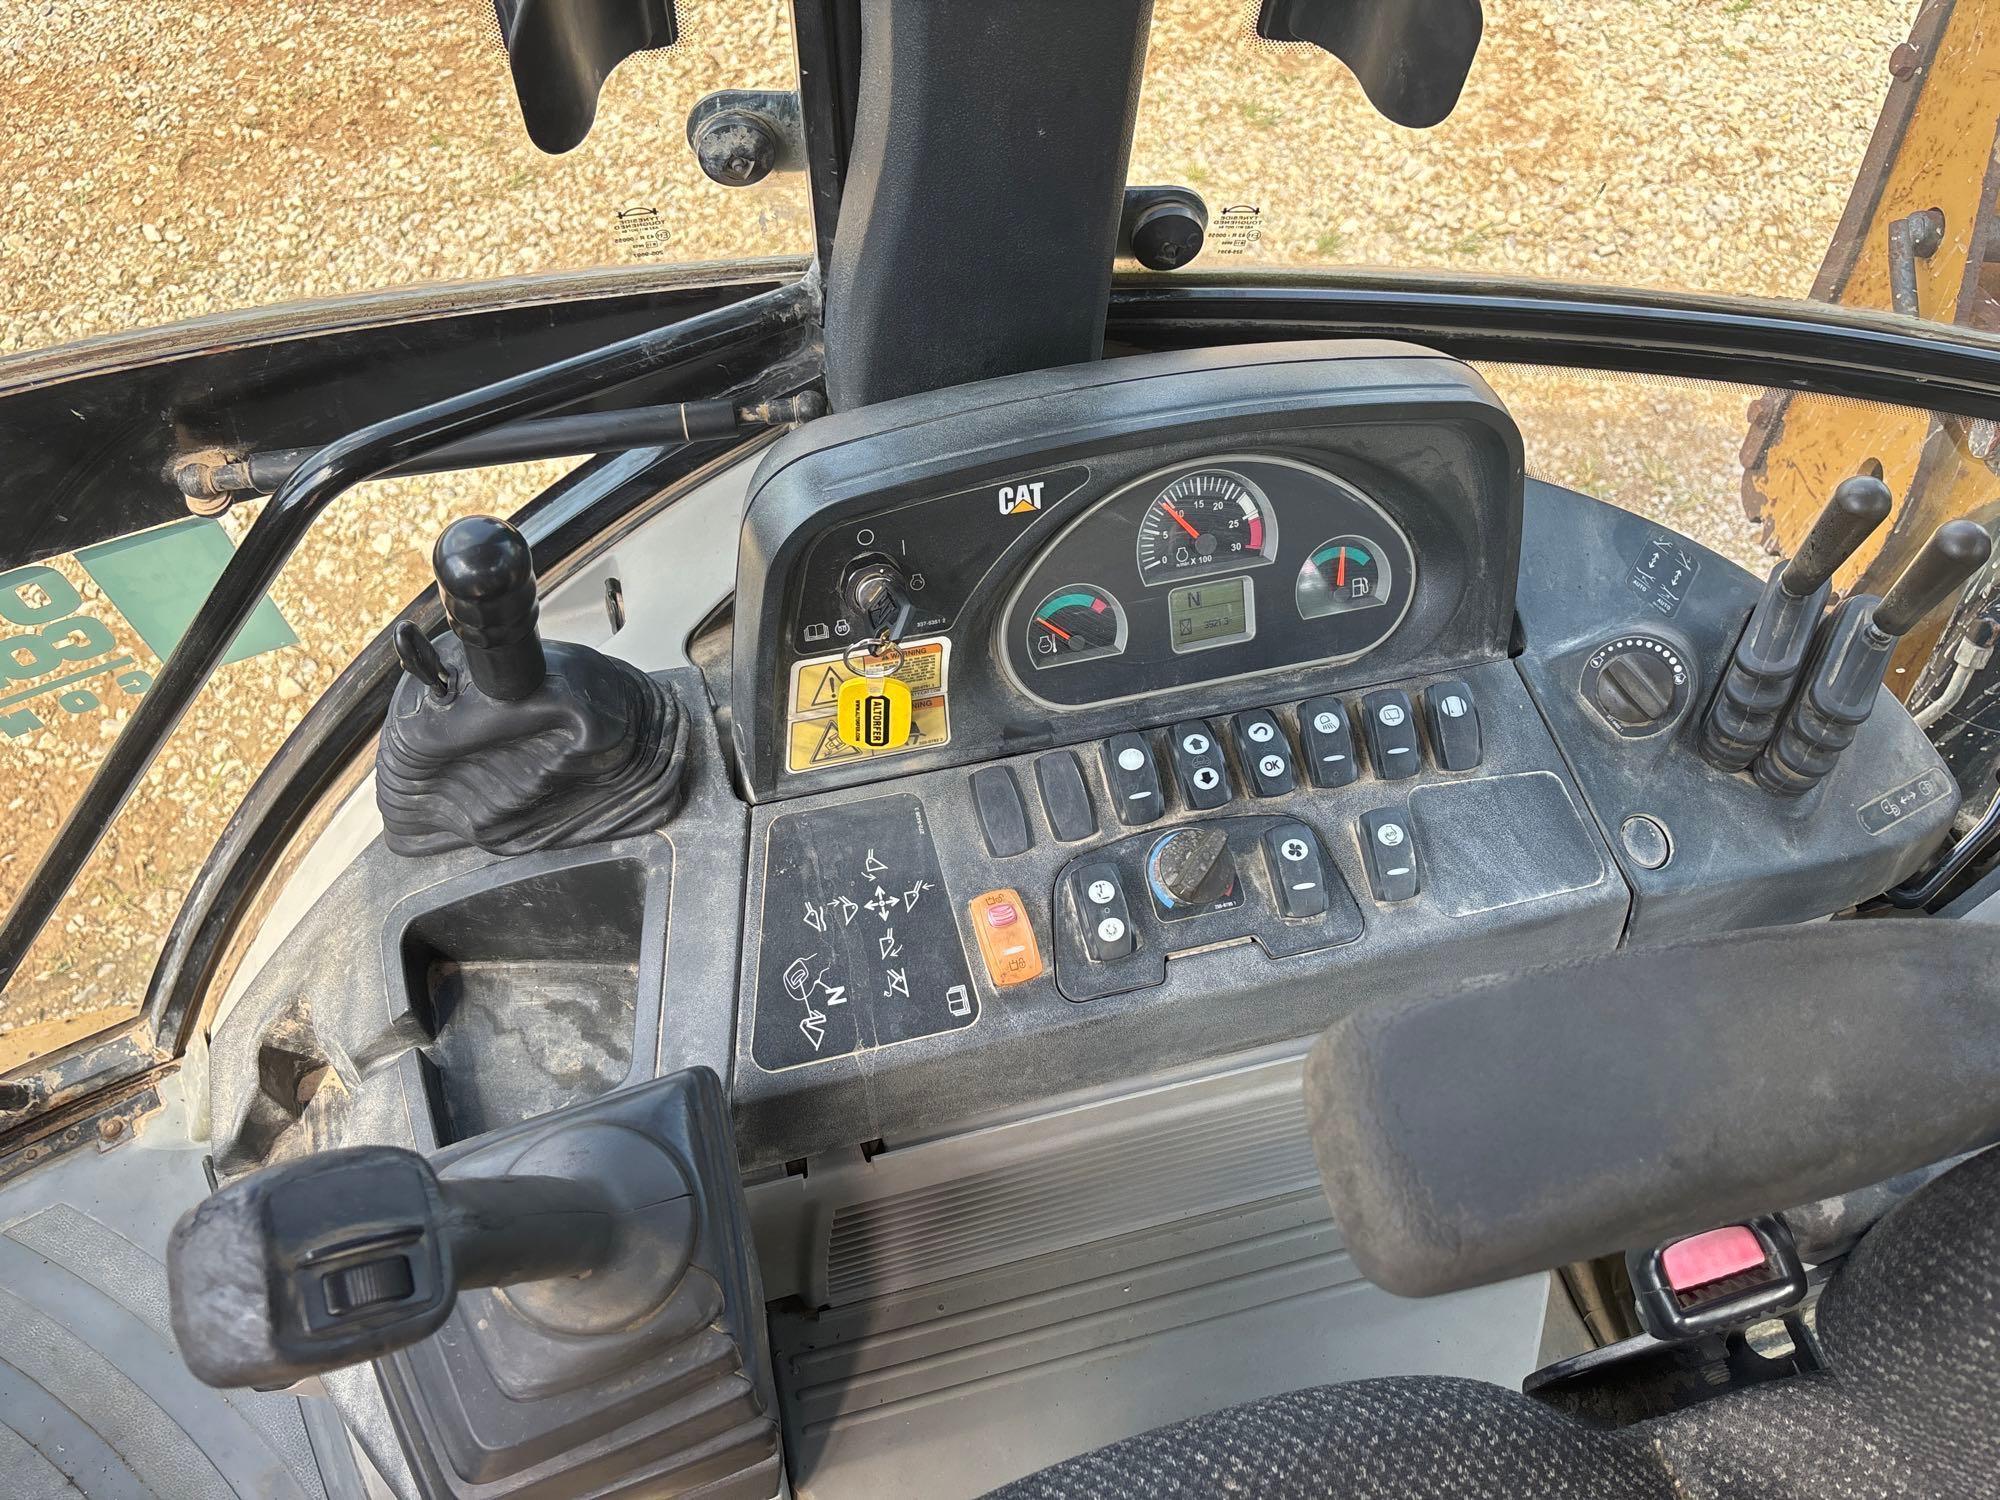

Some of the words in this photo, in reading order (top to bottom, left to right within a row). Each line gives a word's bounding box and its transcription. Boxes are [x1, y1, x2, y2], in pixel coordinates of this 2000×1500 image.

[998, 481, 1045, 515] CAT
[1194, 501, 1205, 509] 15
[1213, 502, 1224, 511] 20
[1228, 520, 1240, 529] 25
[1162, 531, 1169, 540] 5
[1231, 542, 1242, 552] 30
[1161, 556, 1168, 565] 0
[1198, 555, 1213, 564] 100
[1633, 580, 1647, 592] AUTO
[1187, 591, 1202, 608] N
[1657, 598, 1671, 611] AUTO
[872, 701, 883, 741] ALTORFER
[1264, 759, 1281, 771] OK
